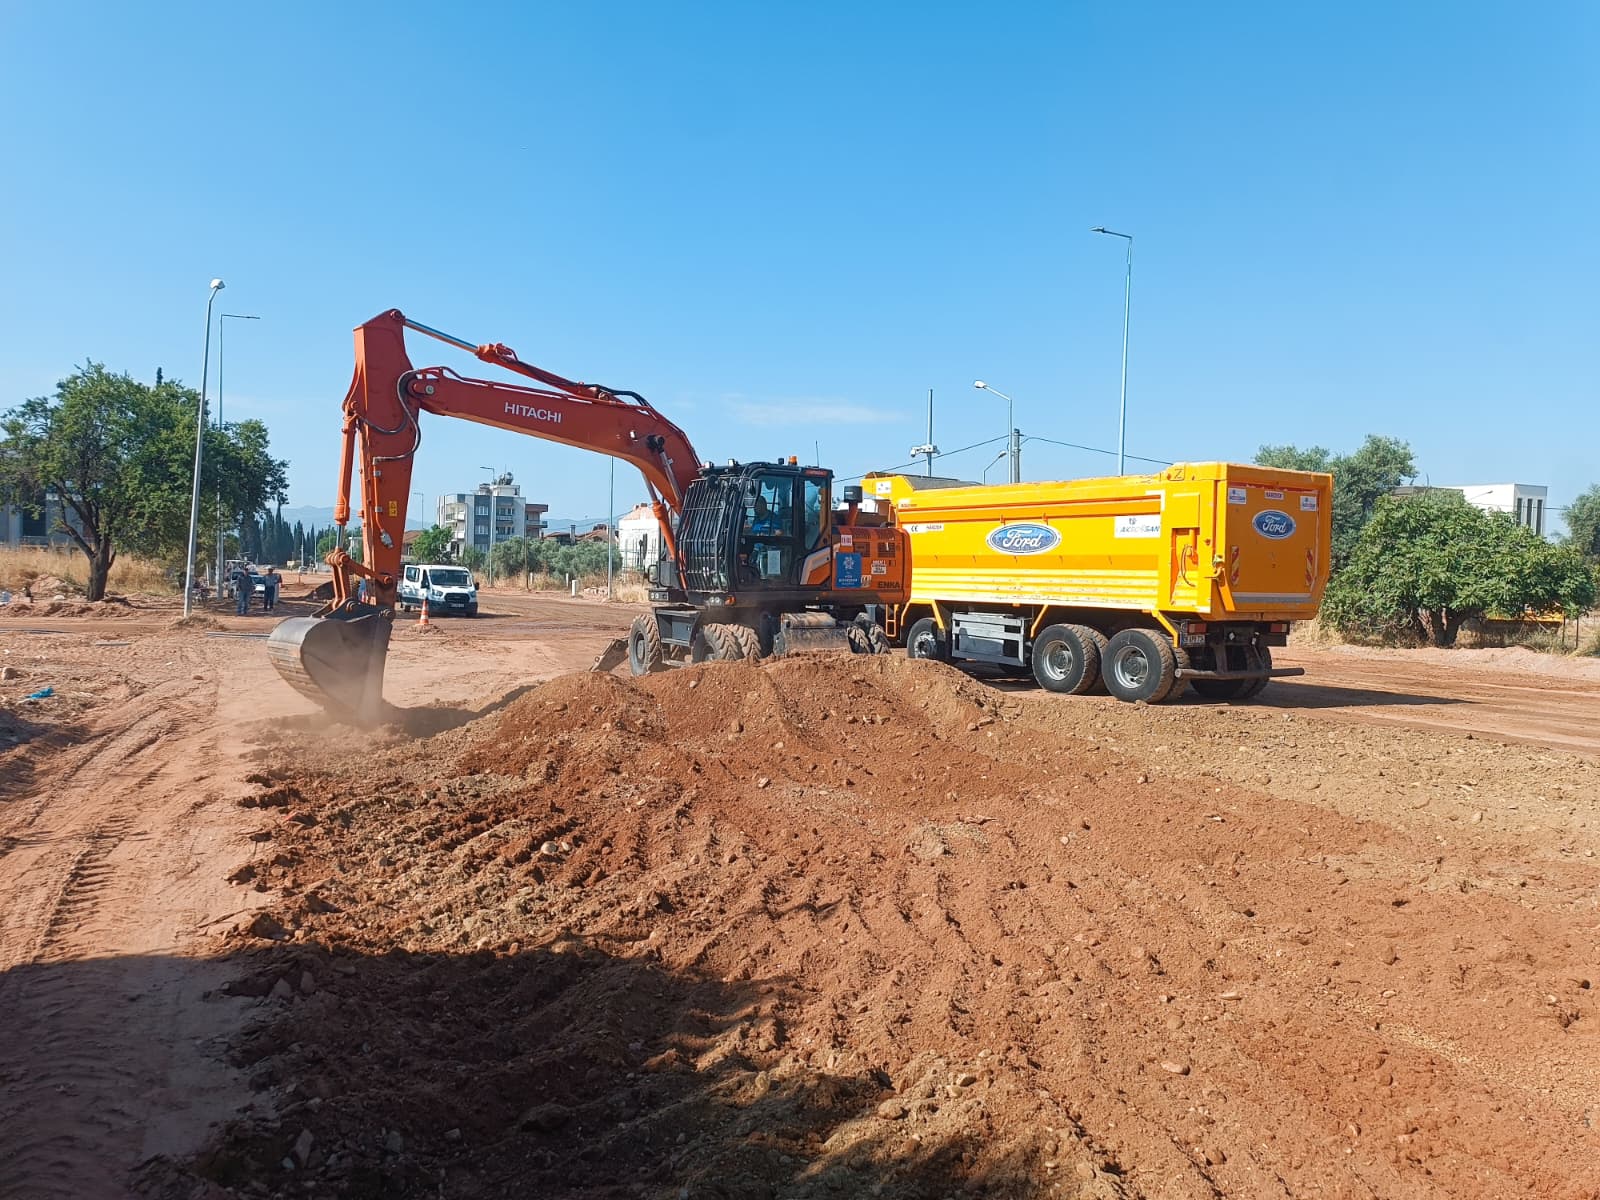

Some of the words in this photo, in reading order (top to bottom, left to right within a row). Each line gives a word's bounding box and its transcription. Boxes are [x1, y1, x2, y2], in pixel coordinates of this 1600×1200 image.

[504, 401, 562, 423] HITACHI
[1262, 515, 1286, 533] Ford
[1002, 529, 1043, 548] Ford
